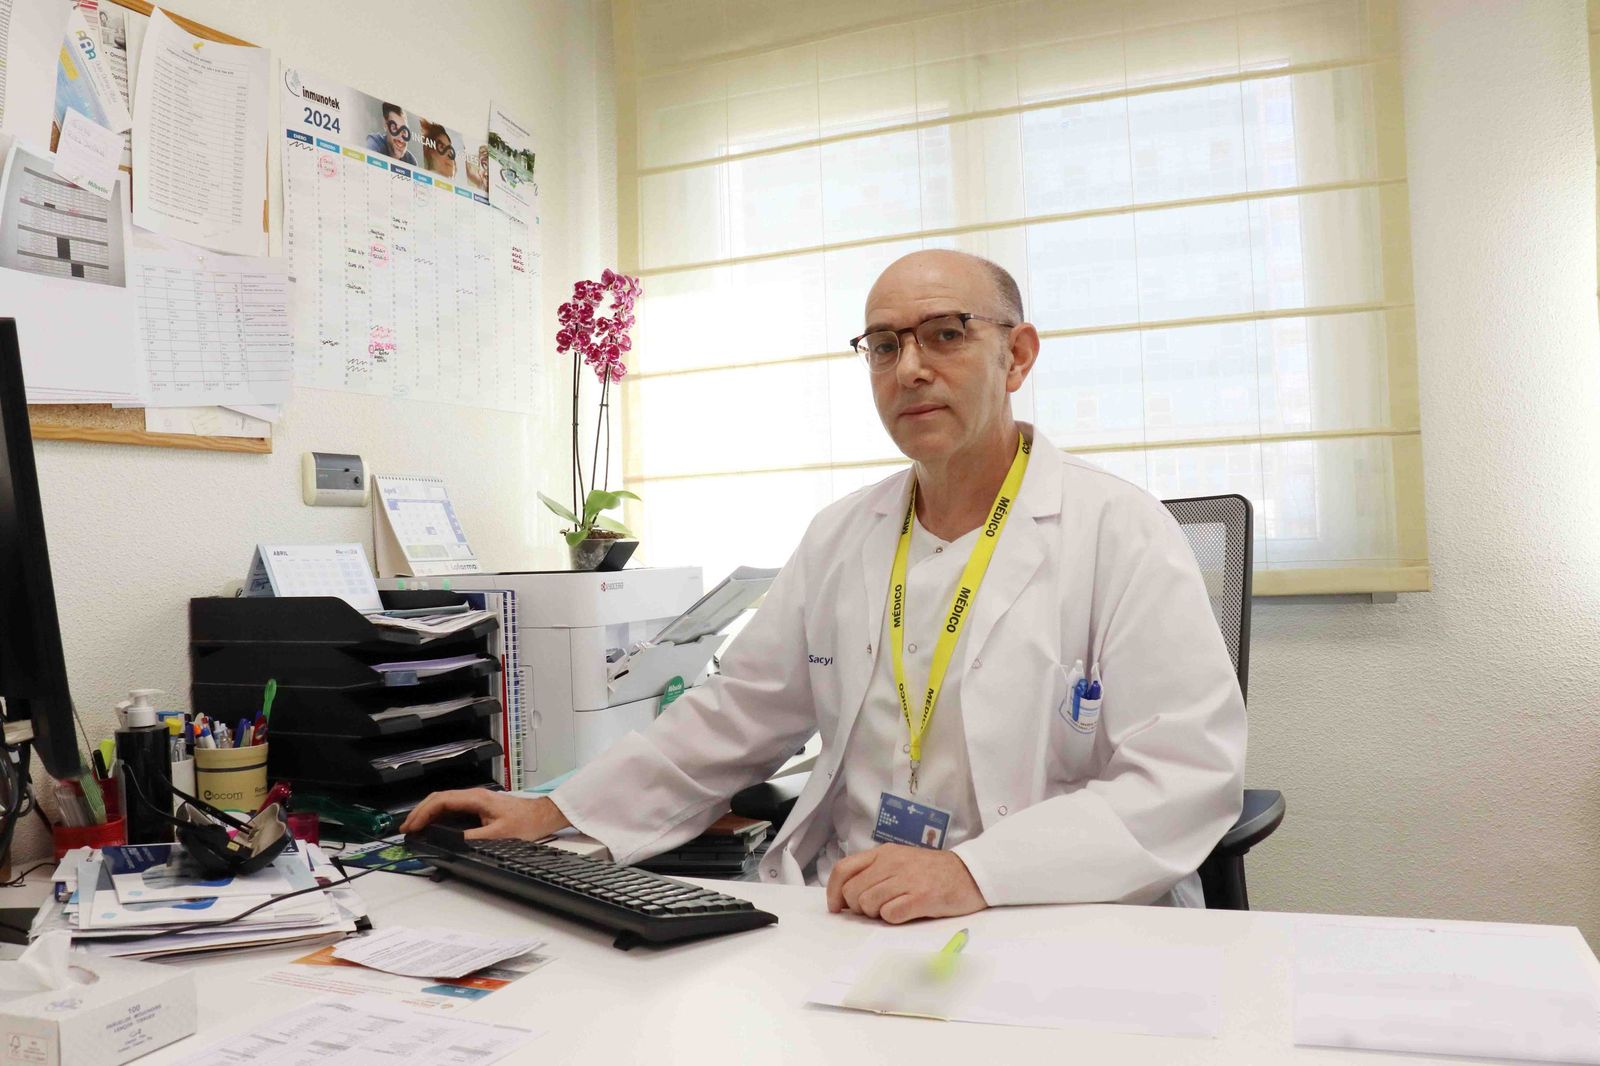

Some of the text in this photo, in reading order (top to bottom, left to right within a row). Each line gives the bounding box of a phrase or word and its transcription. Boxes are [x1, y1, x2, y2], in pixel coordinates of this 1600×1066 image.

[302, 86, 340, 110] inmunotek
[303, 106, 341, 134] 2024
[411, 131, 437, 151] INCAN
[985, 496, 1011, 538] MÉDICO
[893, 584, 903, 629] MÉDICO
[946, 586, 972, 634] MÉDICO
[808, 654, 833, 667] Sacyl
[128, 1004, 141, 1014] 100
